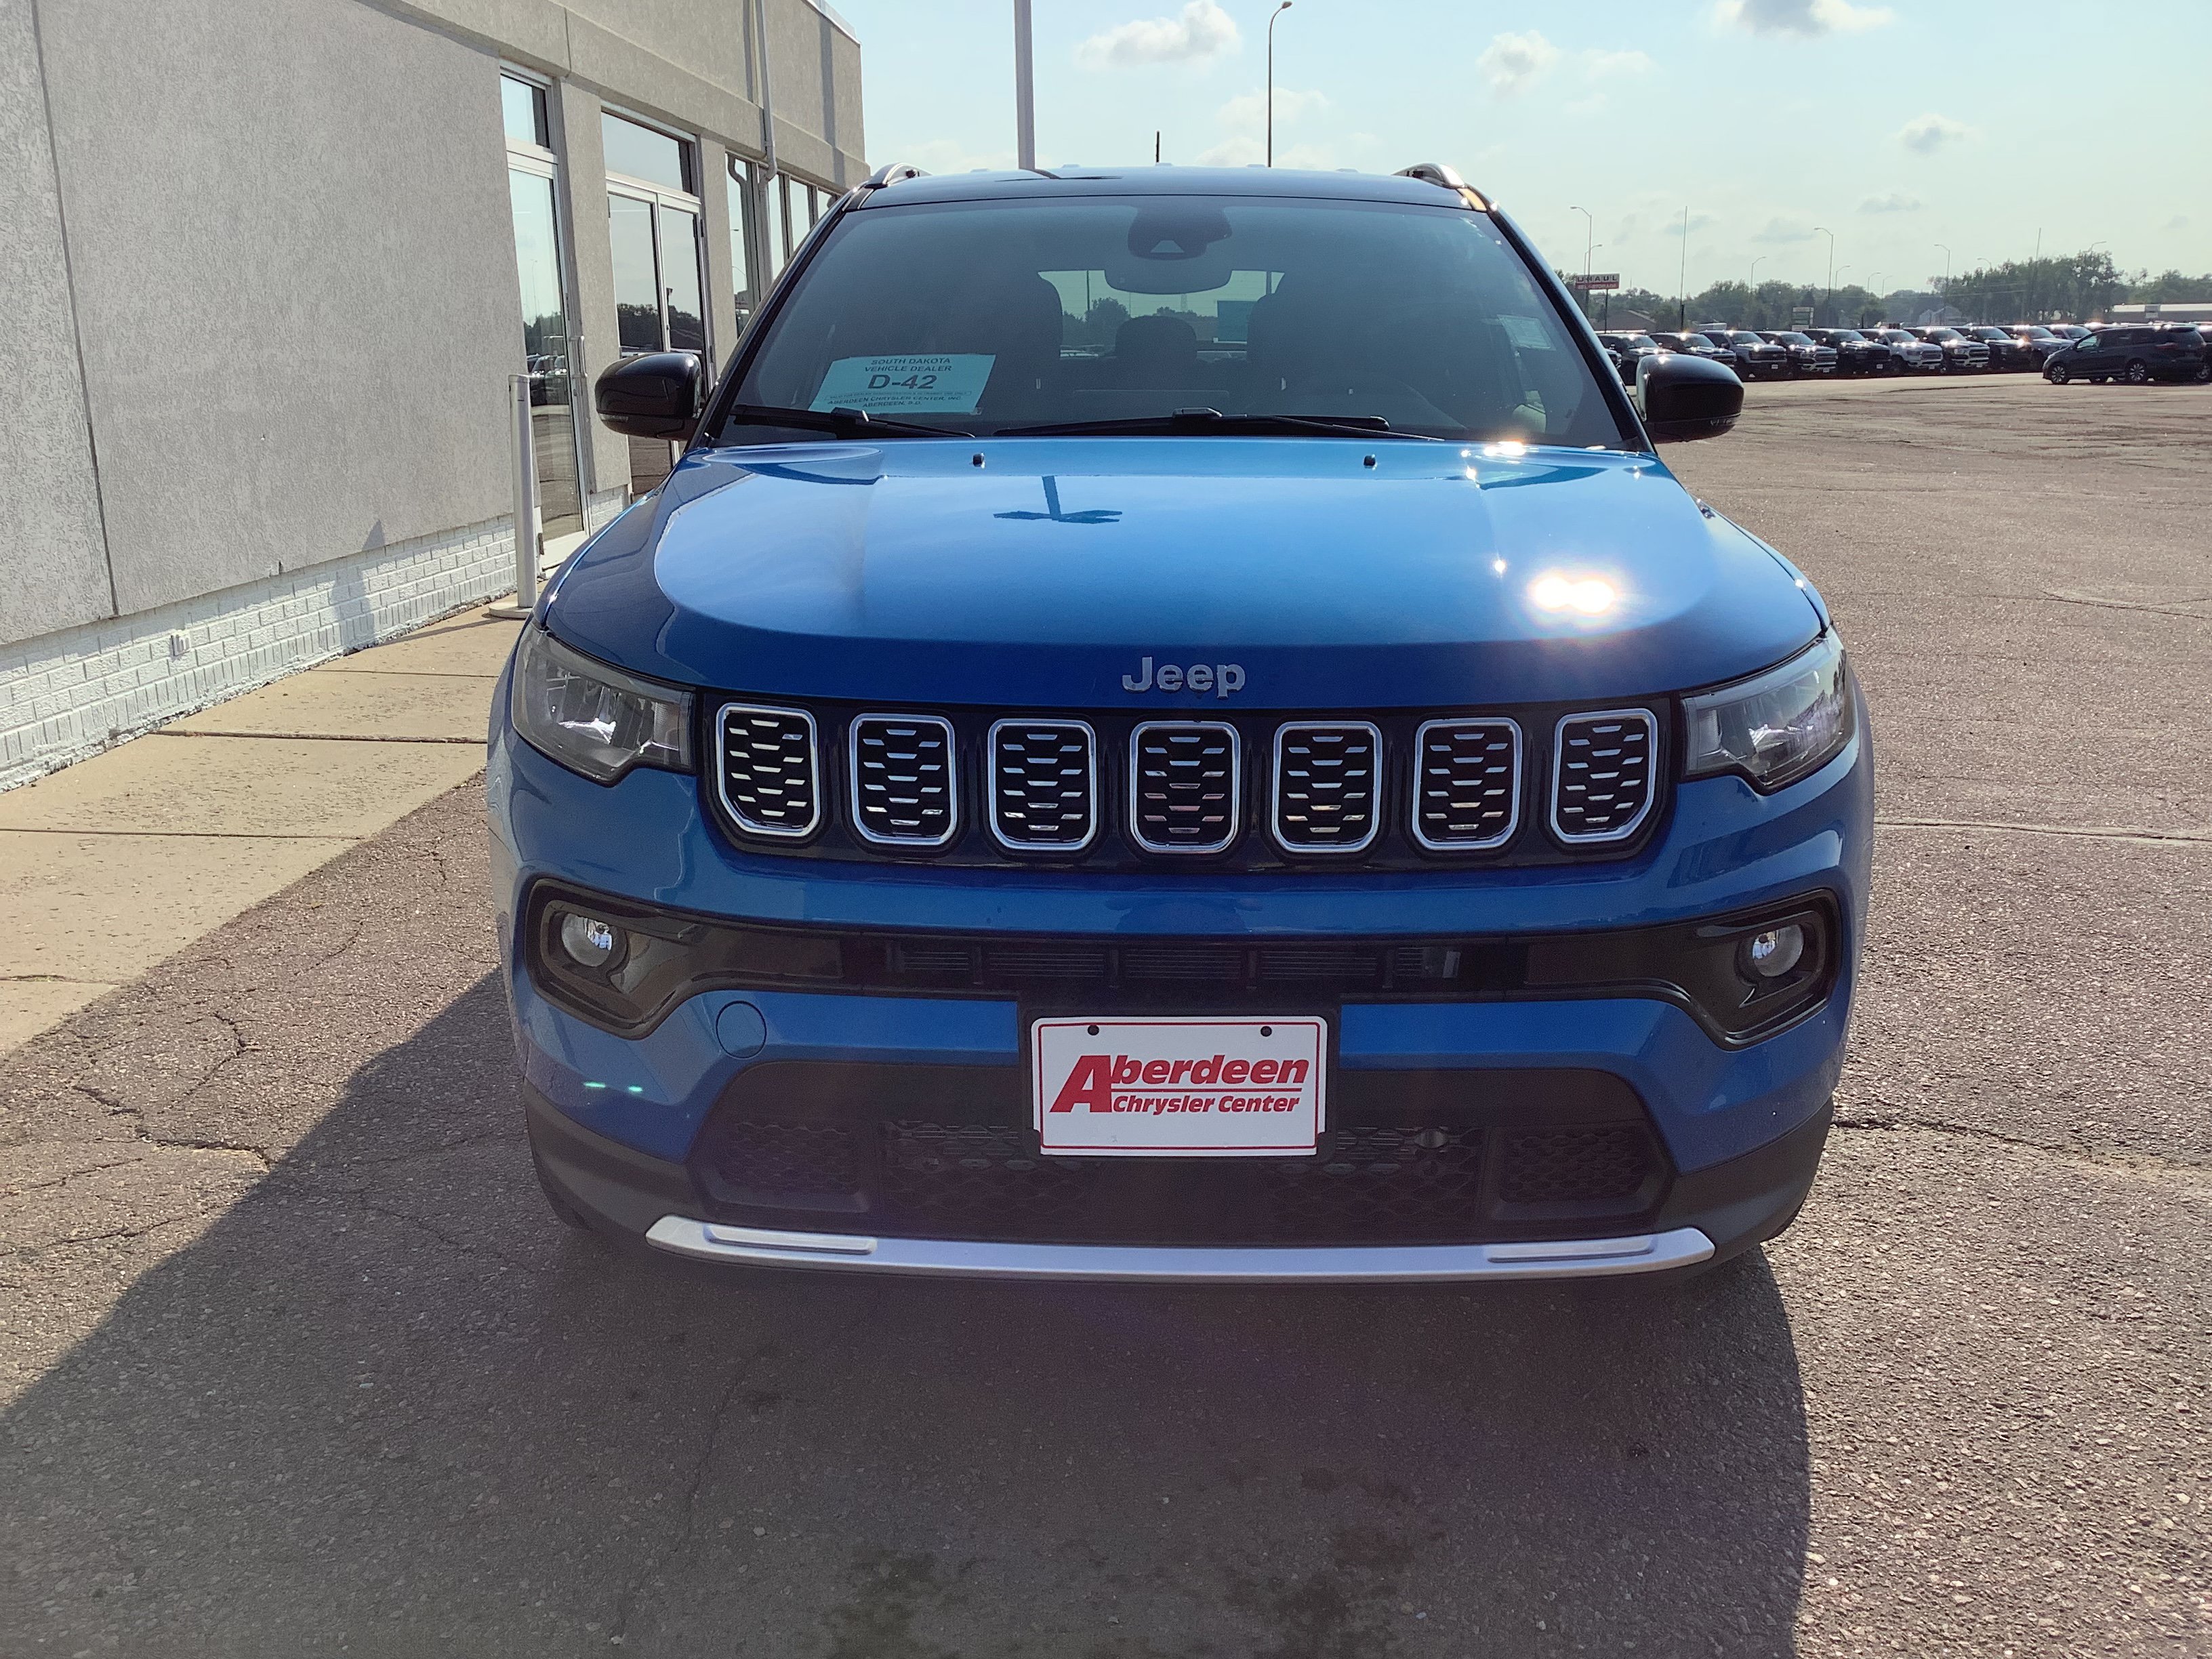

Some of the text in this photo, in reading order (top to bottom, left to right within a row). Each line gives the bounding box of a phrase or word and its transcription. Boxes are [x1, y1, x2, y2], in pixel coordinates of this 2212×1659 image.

[867, 374, 937, 389] D-42
[1122, 656, 1246, 699] Jeep
[1050, 1054, 1309, 1113] Aberdeen
[1113, 1095, 1300, 1115] Chrysler Center
